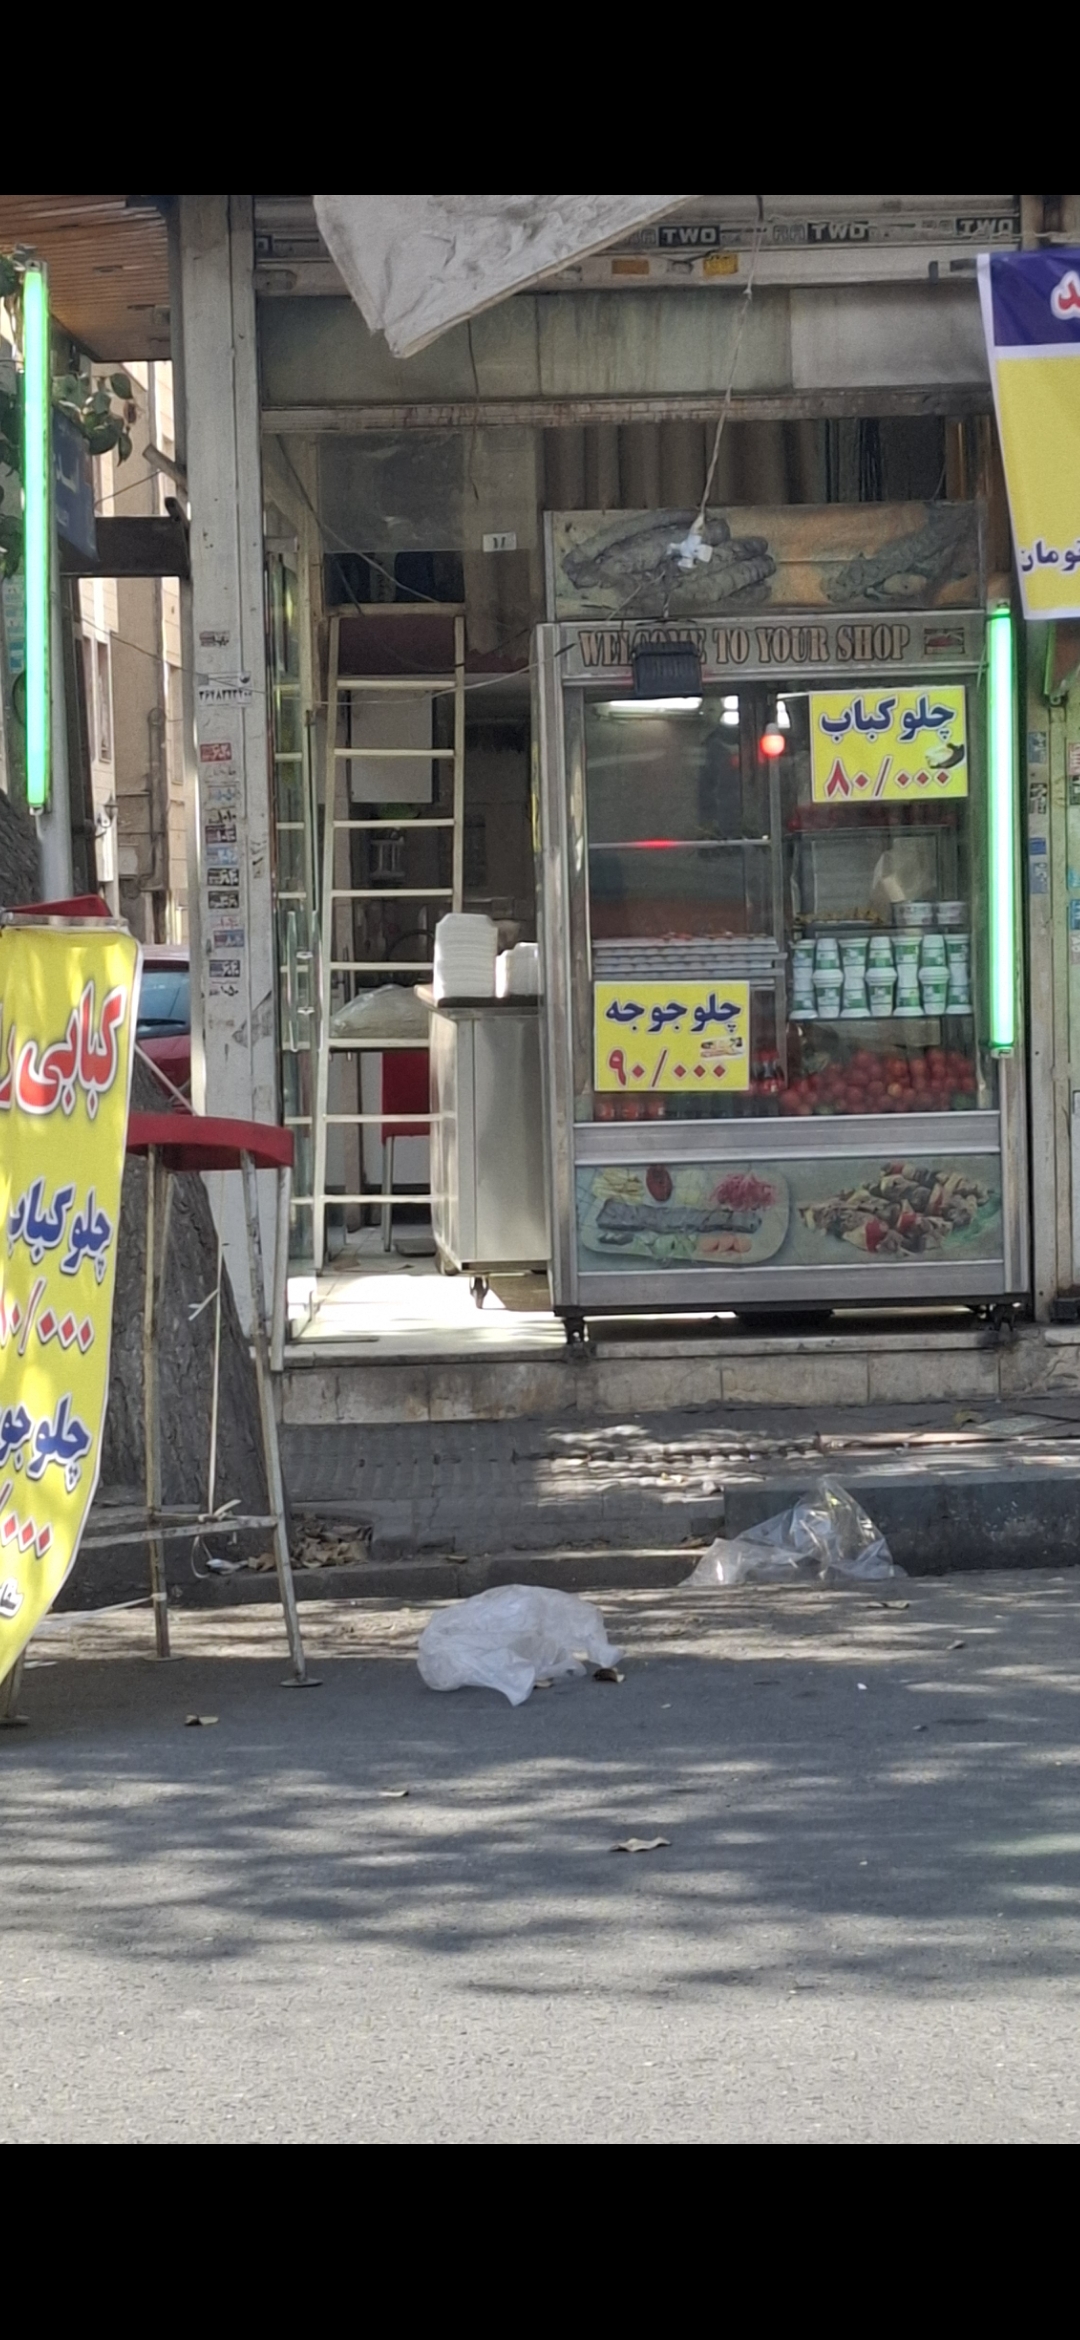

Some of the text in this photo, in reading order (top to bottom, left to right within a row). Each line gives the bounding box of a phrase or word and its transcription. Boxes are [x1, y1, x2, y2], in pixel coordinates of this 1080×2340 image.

[661, 228, 717, 244] TWO
[811, 223, 867, 240] TWO
[713, 627, 749, 664] TO
[755, 626, 830, 664] YOUR
[836, 623, 911, 662] SHOP
[821, 696, 955, 742] چلو کباب
[826, 757, 950, 797] ۸۰/۰۰۰
[690, 993, 742, 1033] چلو
[18, 984, 122, 1112] کبابی
[609, 1049, 726, 1088] ۹۰/۰۰۰
[62, 1188, 111, 1279] چلو
[27, 1395, 91, 1489] چلو
